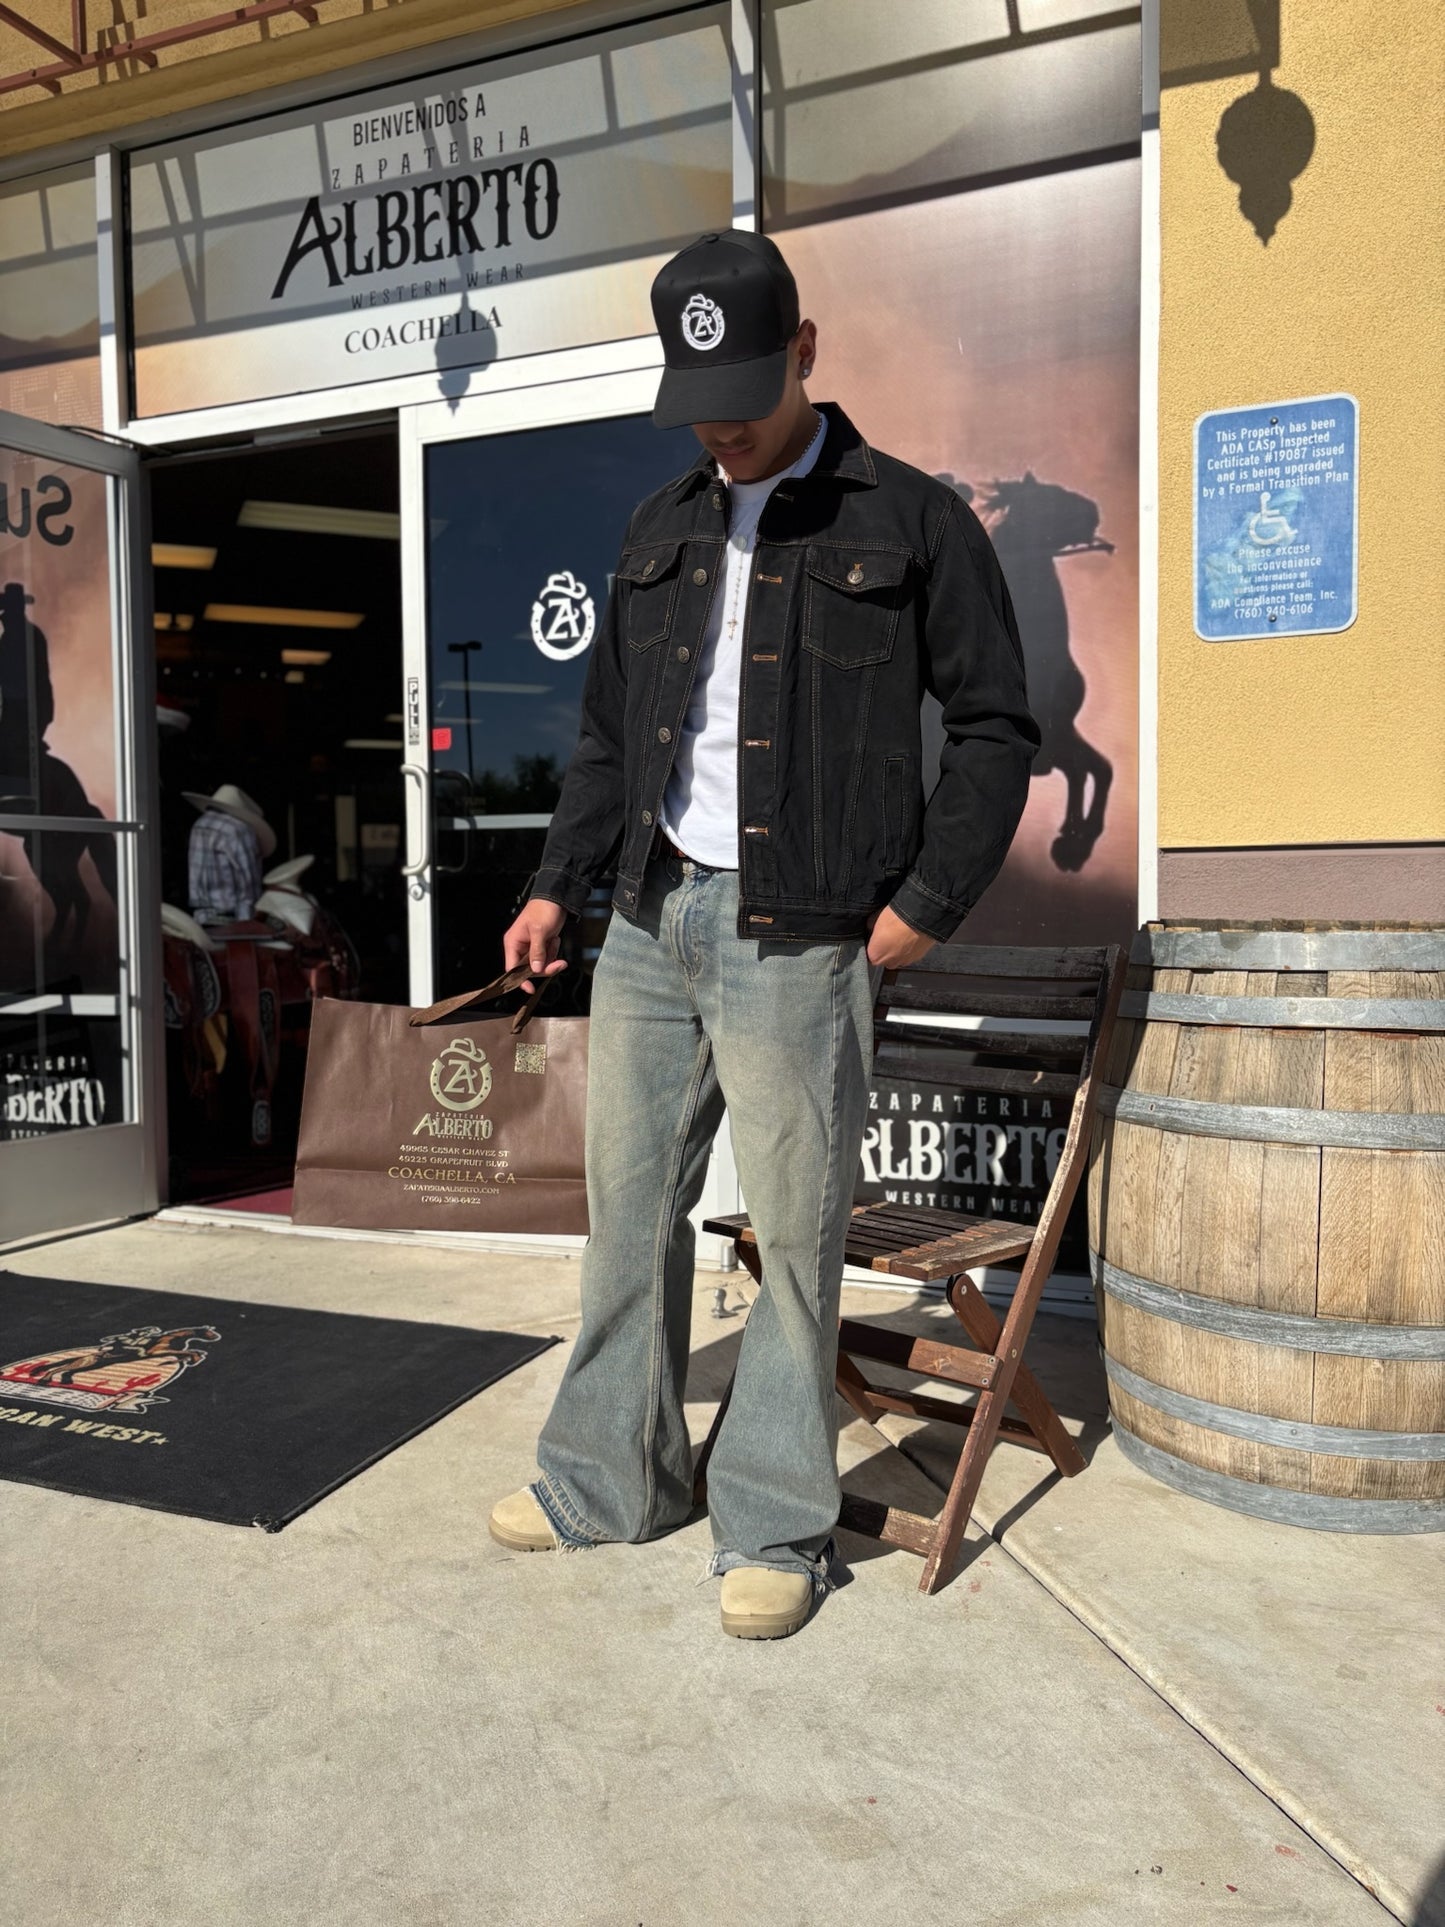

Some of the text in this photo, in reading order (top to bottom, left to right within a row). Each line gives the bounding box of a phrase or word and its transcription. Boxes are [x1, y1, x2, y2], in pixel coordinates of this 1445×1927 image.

[353, 93, 486, 147] BIENVENIDOS A
[332, 125, 530, 190] ZAPATERIA
[270, 157, 561, 299] ALBERTO
[351, 263, 524, 310] WESTERN WEAR
[344, 306, 503, 354] COACHELLA
[1216, 419, 1335, 442] This Property has been
[1221, 431, 1330, 455] ADA CASp Inspected
[1207, 443, 1345, 470] Certificate #19087 issued
[1217, 458, 1334, 483] and is being upgraded
[1203, 471, 1349, 499] by a Formal Transition Plan
[1239, 544, 1311, 559] Please excuse
[1227, 556, 1322, 574] the inconvenience
[1254, 571, 1298, 582] information
[1300, 570, 1308, 579] or
[1270, 582, 1294, 593] please
[1296, 579, 1314, 589] call:
[1211, 598, 1231, 609] ADA
[1234, 594, 1286, 608] Compliance
[1320, 589, 1338, 600] Inc.
[1234, 603, 1313, 619] (760) 940-6106
[408, 681, 419, 729] PULL
[4, 1073, 105, 1127] BERTO
[869, 1092, 1053, 1117] ZAPATERIA
[412, 1113, 494, 1139] ALBERTO
[398, 1155, 509, 1168] 49225 GRAPEFRUIT BLVD
[431, 1146, 460, 1155] CESAR
[462, 1148, 496, 1157] CHAVEZ
[498, 1150, 511, 1158] ST
[388, 1166, 517, 1184] COACHELLA, CA
[421, 1195, 442, 1204] (760)
[885, 1190, 975, 1210] WESTERN
[0, 1406, 160, 1444] CAN WEST
